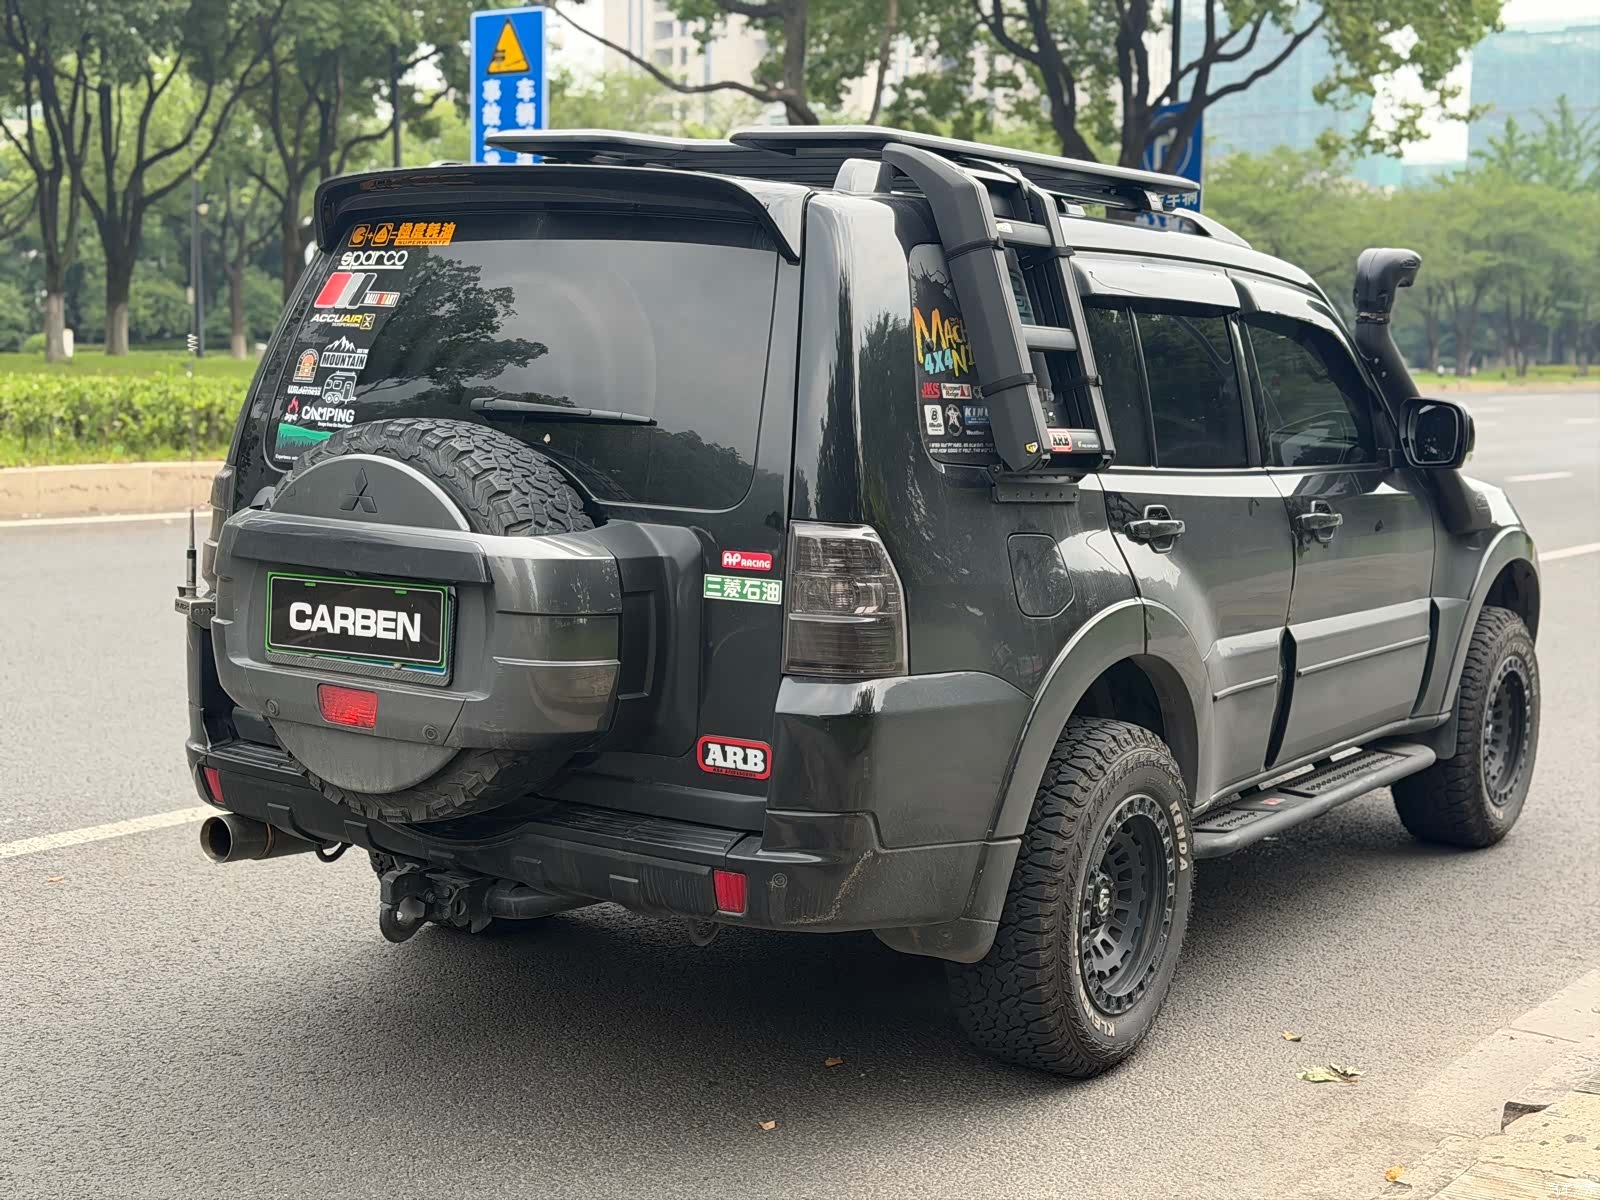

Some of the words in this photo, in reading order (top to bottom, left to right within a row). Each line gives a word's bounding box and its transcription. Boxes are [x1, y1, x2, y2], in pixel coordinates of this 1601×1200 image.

[340, 250, 408, 269] sparco
[310, 313, 363, 323] ACCUAIR
[321, 353, 367, 368] MOUNTAIN
[924, 349, 953, 375] 4X4
[922, 382, 940, 396] JKS
[301, 406, 355, 423] CAMPING
[723, 552, 741, 566] AP
[741, 559, 771, 569] RACING
[706, 576, 780, 602] 三菱石油
[289, 602, 421, 642] CARBEN
[705, 743, 765, 772] ARB
[1169, 800, 1188, 871] KENDA
